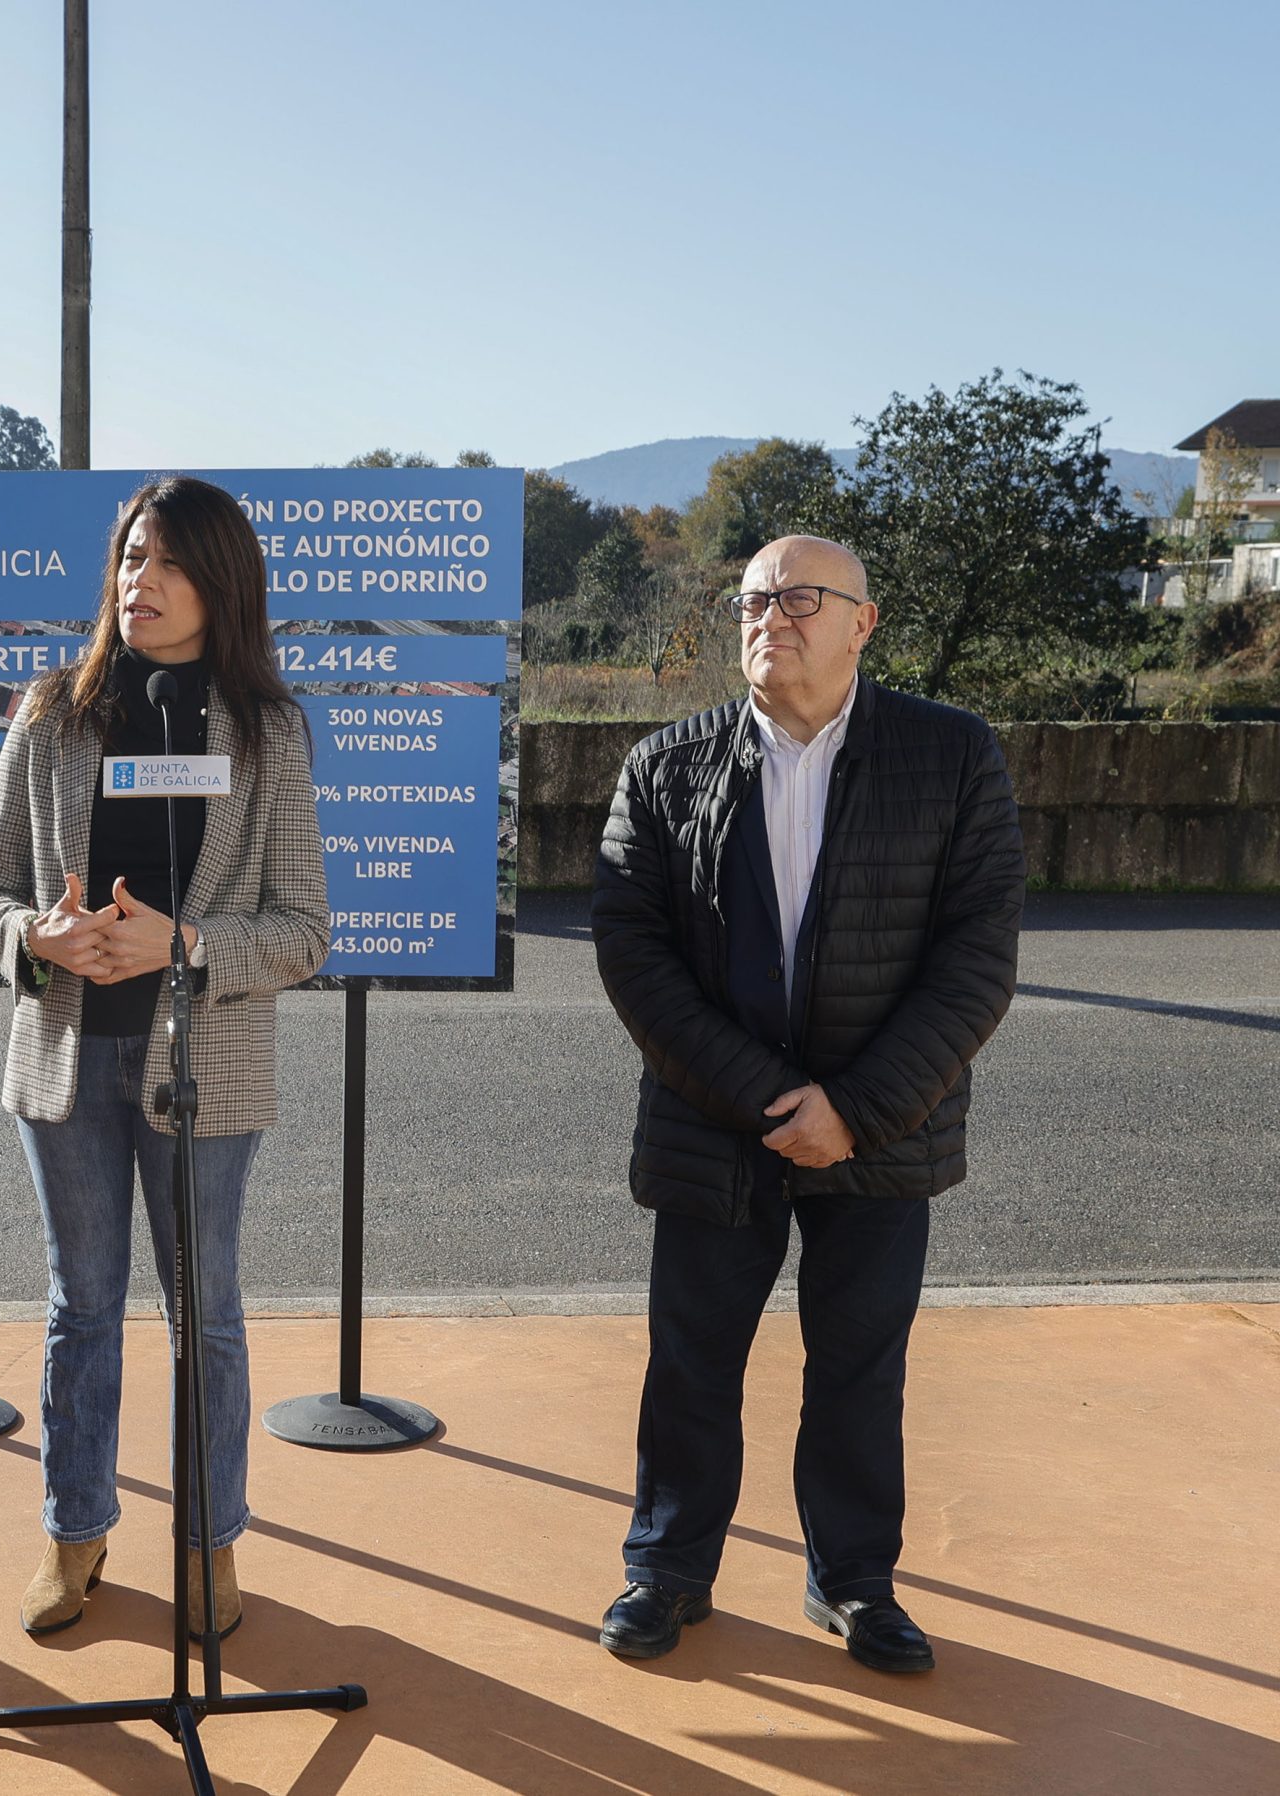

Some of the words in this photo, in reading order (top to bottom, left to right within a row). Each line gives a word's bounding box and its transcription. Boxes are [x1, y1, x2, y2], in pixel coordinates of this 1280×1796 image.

[237, 493, 274, 523] ÓN
[284, 500, 323, 522] DO
[334, 499, 483, 522] PROXECTO
[259, 535, 286, 557] SE
[293, 528, 490, 557] AUTONÓMICO
[318, 570, 352, 592] DE
[362, 563, 488, 592] PORRIÑO
[275, 646, 397, 671] 12.414€
[328, 709, 366, 726] 300
[374, 709, 443, 726] NOVAS
[334, 734, 437, 752] VIVENDAS
[141, 764, 190, 774] XUNTA
[140, 776, 158, 786] DE
[163, 776, 221, 786] GALICIA
[313, 786, 341, 802] 0%
[347, 786, 476, 802] PROTEXIDAS
[364, 836, 455, 853] VIVENDA
[355, 862, 412, 878] LIBRE
[430, 912, 456, 929] DE
[331, 937, 402, 954] 43.000
